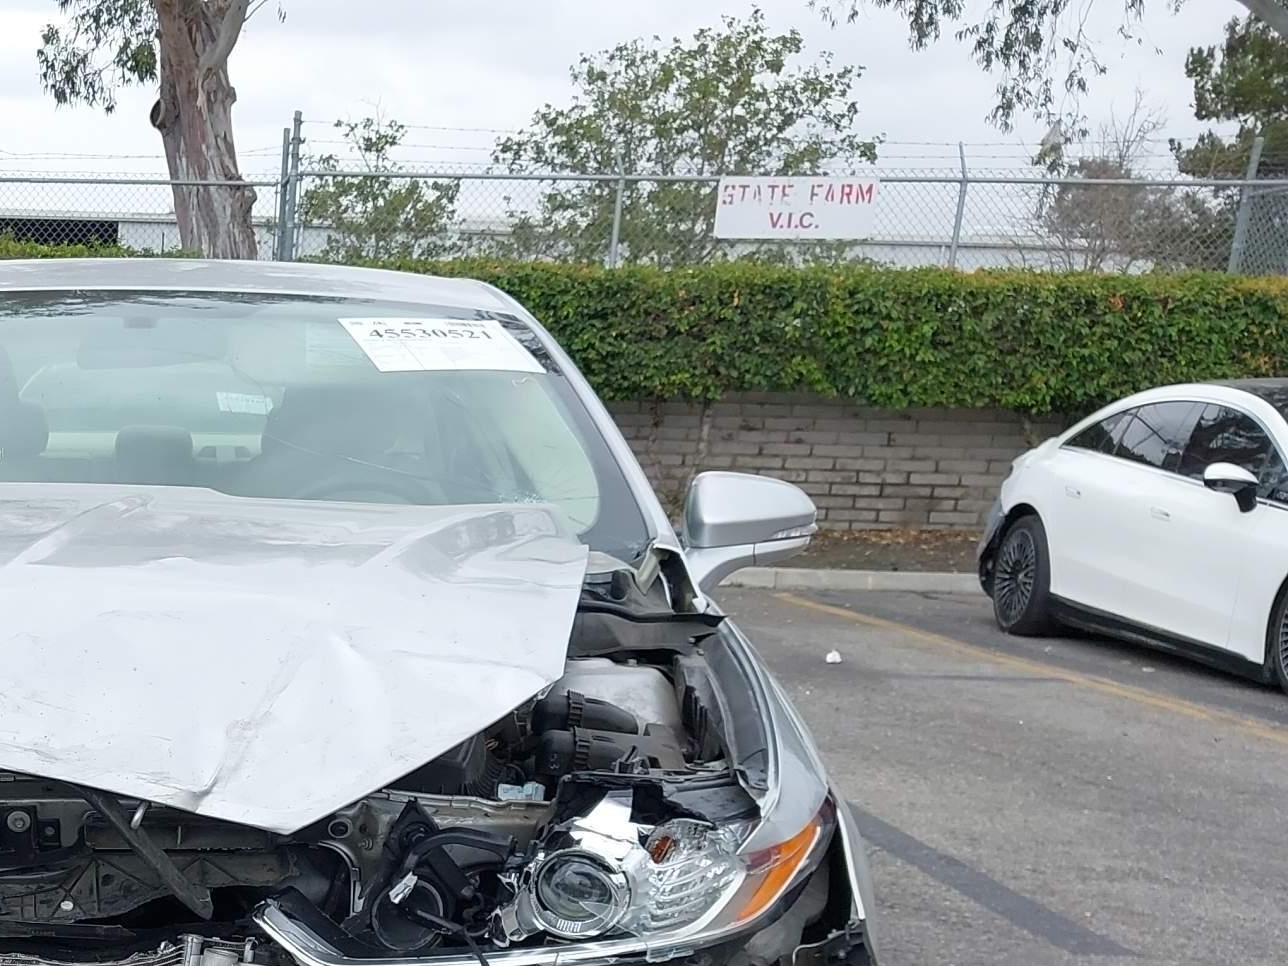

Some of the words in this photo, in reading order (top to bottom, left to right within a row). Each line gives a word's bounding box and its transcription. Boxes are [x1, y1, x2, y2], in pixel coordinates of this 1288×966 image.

[722, 184, 794, 206] STATE
[810, 183, 874, 205] FARM
[768, 212, 820, 229] V.I.C.
[369, 328, 492, 340] 45530521
